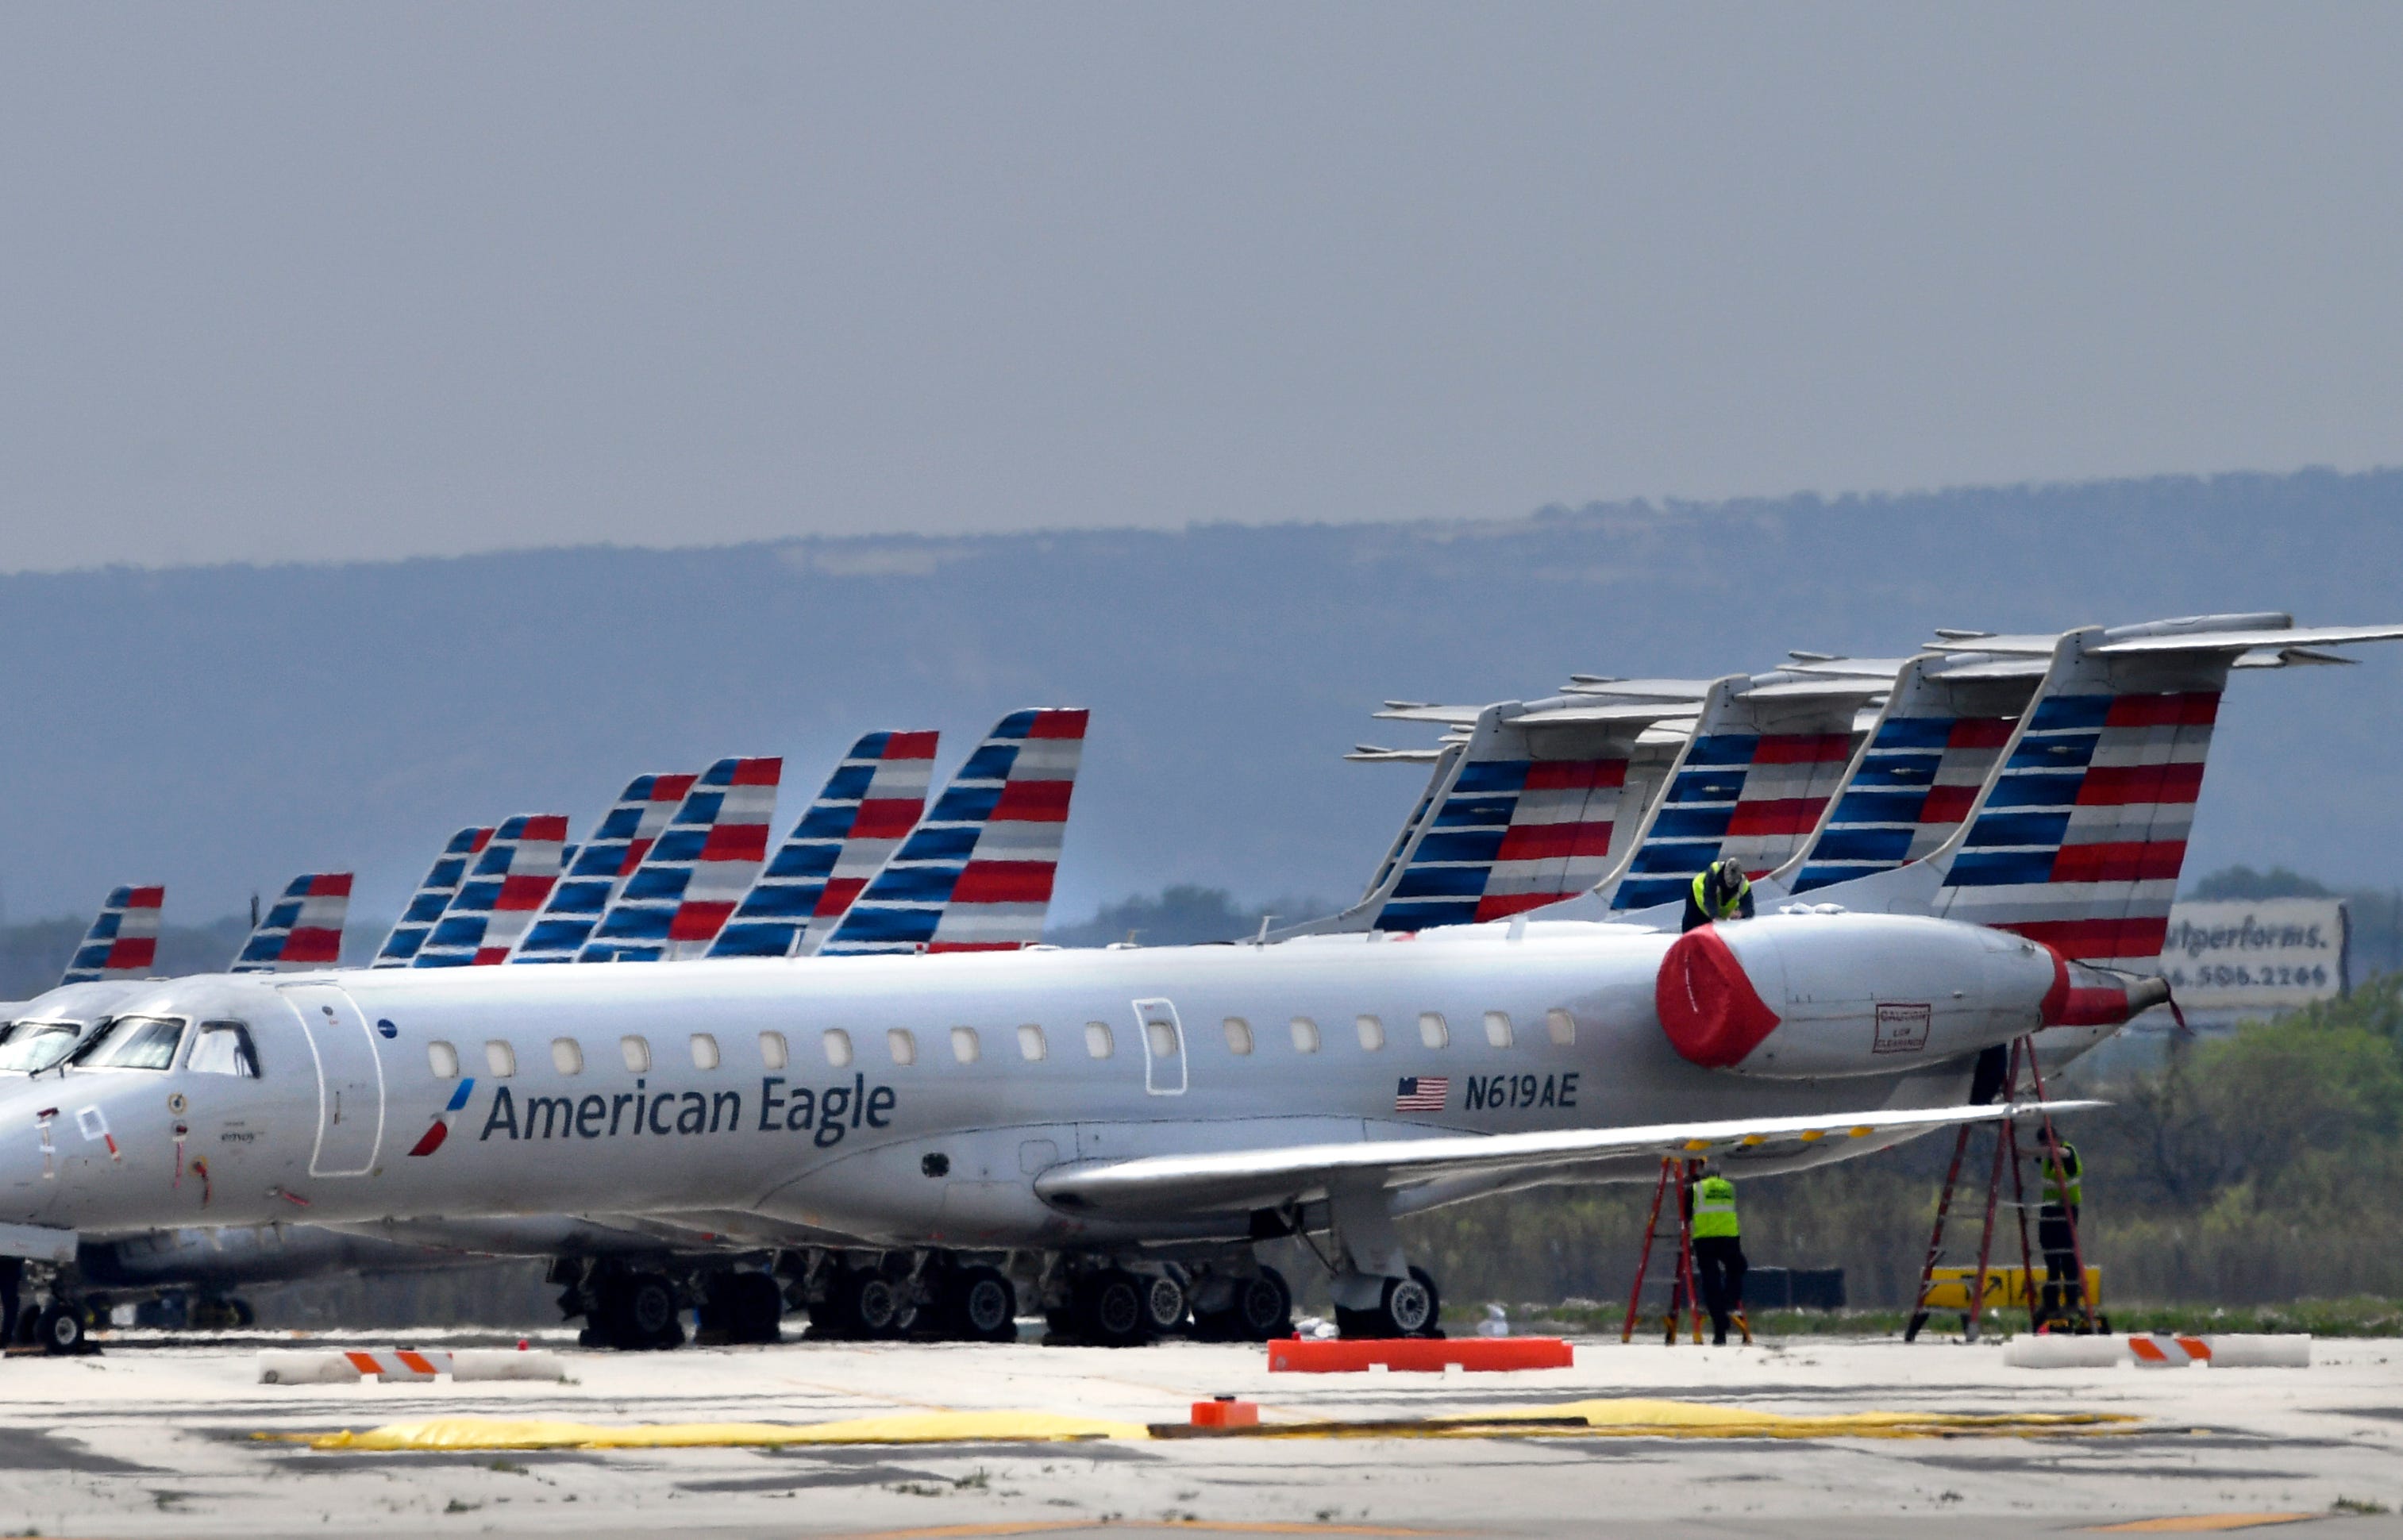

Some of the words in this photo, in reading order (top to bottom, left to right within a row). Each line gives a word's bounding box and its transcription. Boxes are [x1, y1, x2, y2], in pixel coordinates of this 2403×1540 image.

[1880, 1010, 1927, 1022] CAUTION
[479, 1078, 741, 1142] American
[758, 1072, 895, 1148] Eagle
[1465, 1072, 1580, 1110] N619AE
